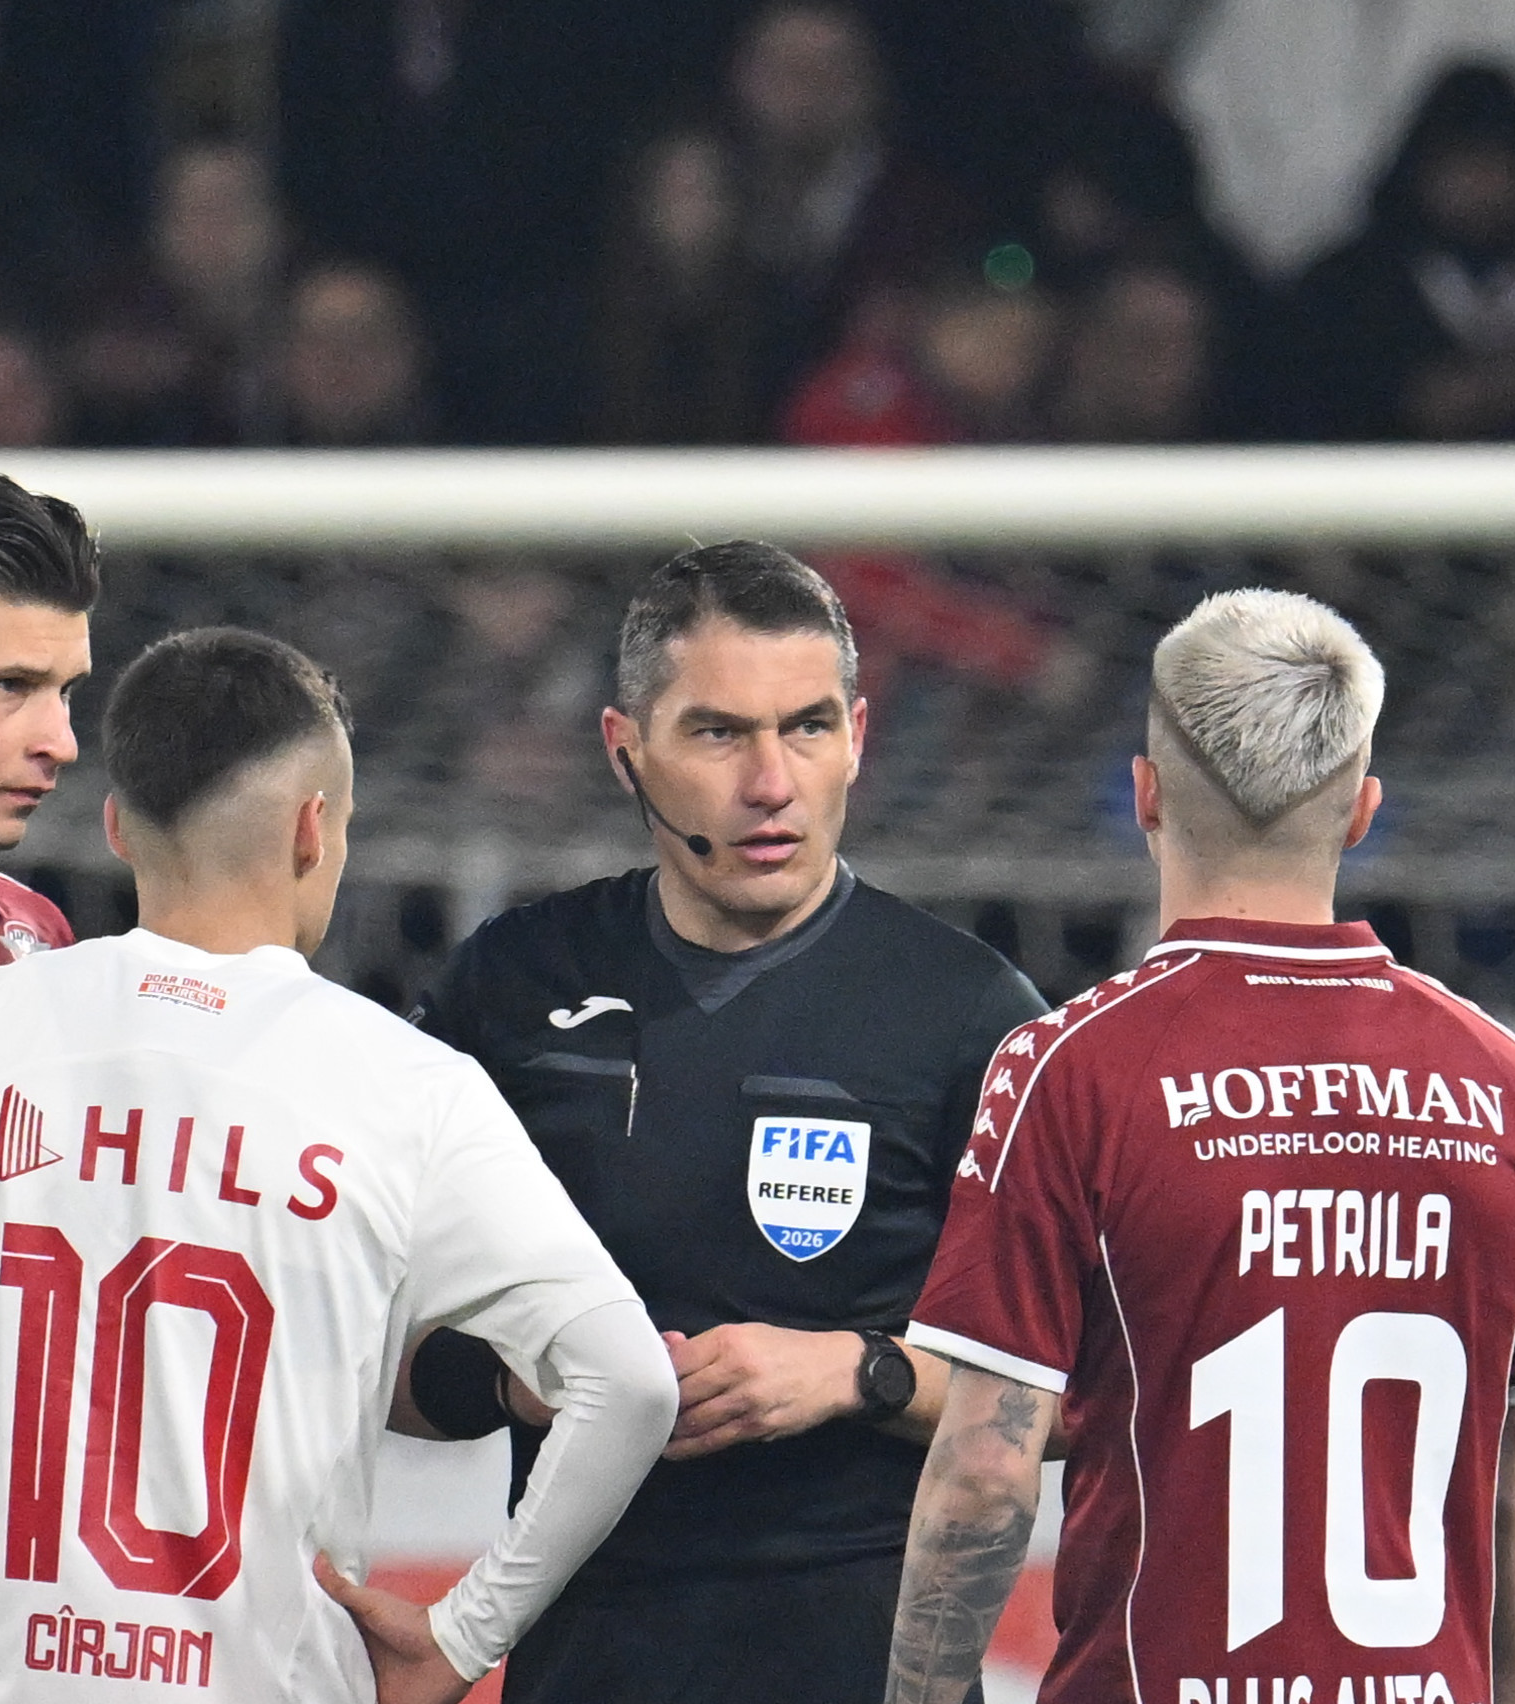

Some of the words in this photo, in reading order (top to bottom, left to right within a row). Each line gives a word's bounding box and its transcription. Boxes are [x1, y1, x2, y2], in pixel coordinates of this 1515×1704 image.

[1159, 1063, 1505, 1136] HOFFMAN
[79, 1105, 345, 1221] HILS
[761, 1126, 856, 1164] FIFA
[1194, 1131, 1380, 1161] UNDERFLOOR
[1387, 1136, 1498, 1166] HEATING
[758, 1181, 854, 1205] REFEREE
[780, 1230, 824, 1248] 2026
[1238, 1188, 1452, 1281] PETRILA
[1189, 1306, 1468, 1653] 10
[24, 1604, 214, 1687] CÎRJAN
